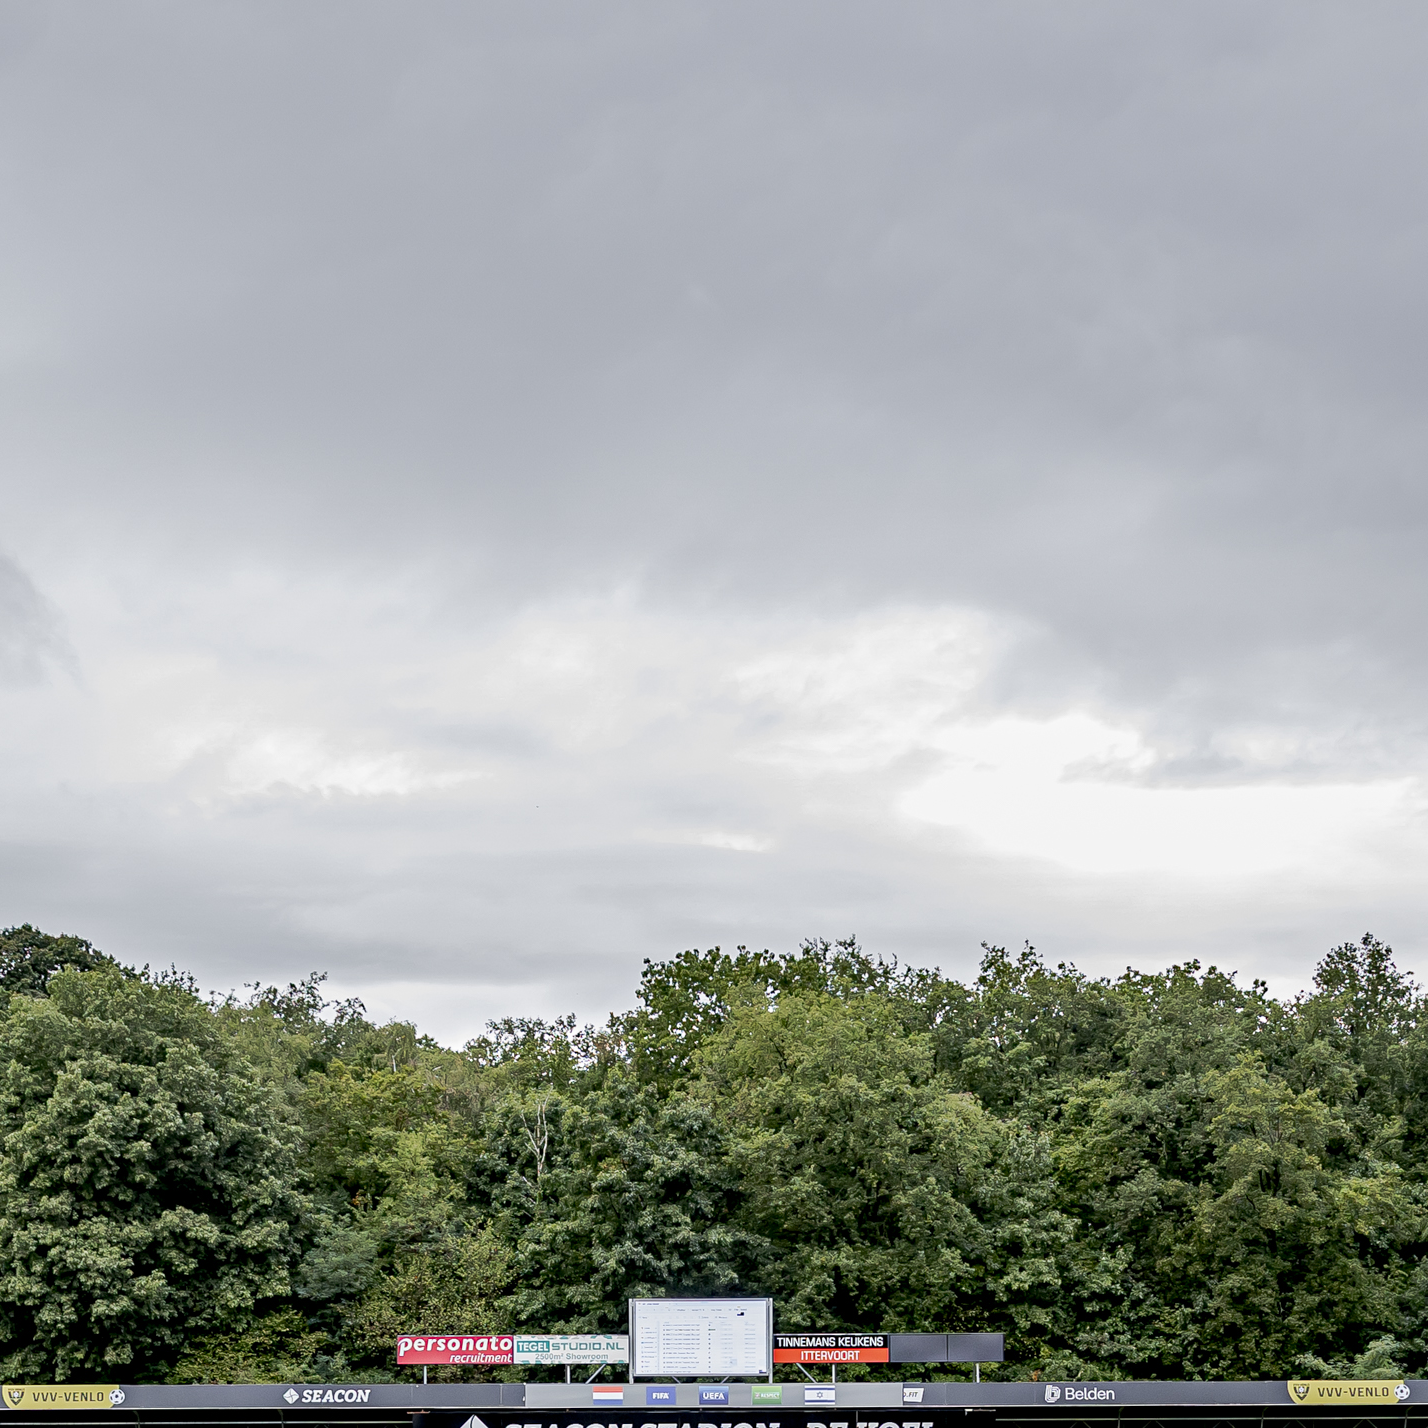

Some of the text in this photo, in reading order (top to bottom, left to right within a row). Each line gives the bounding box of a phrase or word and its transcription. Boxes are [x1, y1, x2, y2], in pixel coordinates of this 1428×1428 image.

[398, 1336, 513, 1357] personato
[777, 1337, 884, 1347] TINNEMANS KEUKENS
[449, 1352, 513, 1363] recruitment
[801, 1351, 860, 1360] ITTERVOORT
[32, 1391, 104, 1402] VVV-VENLO
[302, 1390, 371, 1403] SEACON
[652, 1391, 670, 1400] FIFA
[702, 1391, 725, 1400] UEFA
[1064, 1387, 1115, 1401] Belden
[1318, 1387, 1389, 1397] VVV-VENLO
